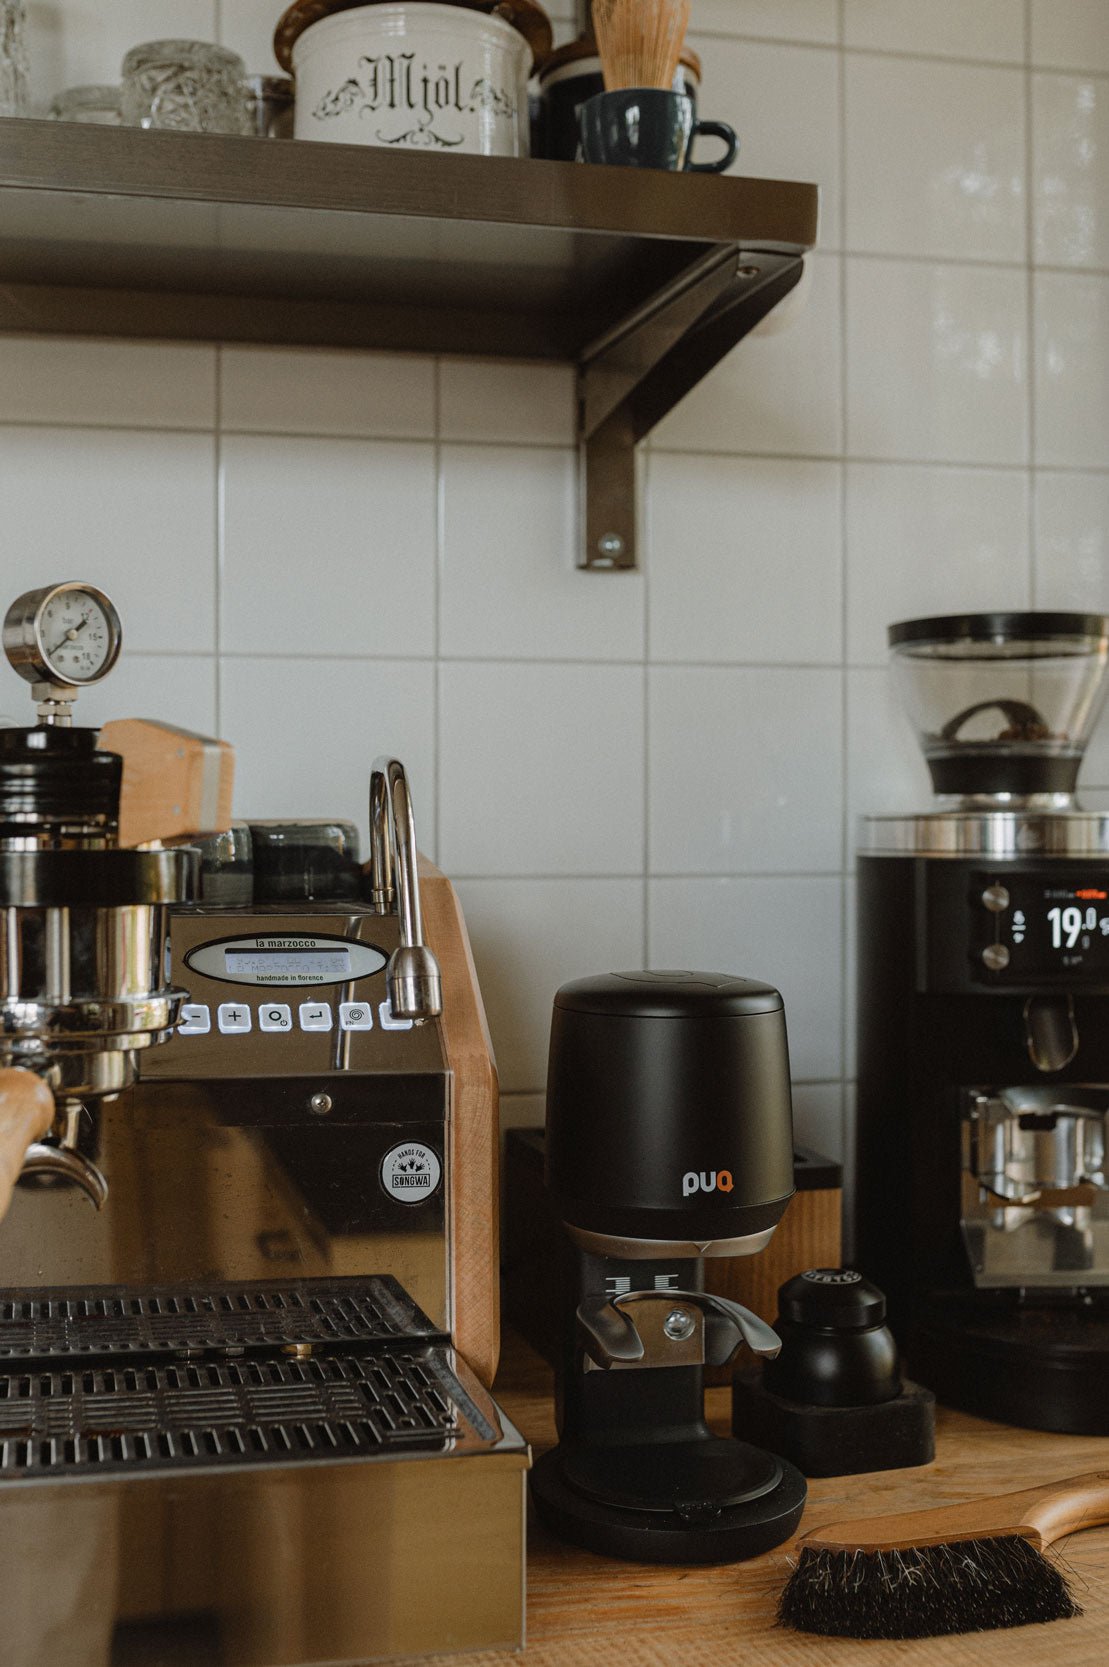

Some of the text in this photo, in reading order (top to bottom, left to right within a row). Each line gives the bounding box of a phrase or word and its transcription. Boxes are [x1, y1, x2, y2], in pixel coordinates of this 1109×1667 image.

[255, 938, 317, 948] la marzocco
[256, 974, 289, 982] handmade
[397, 1148, 426, 1160] HANDS FOR
[394, 1175, 429, 1187] SONGWA
